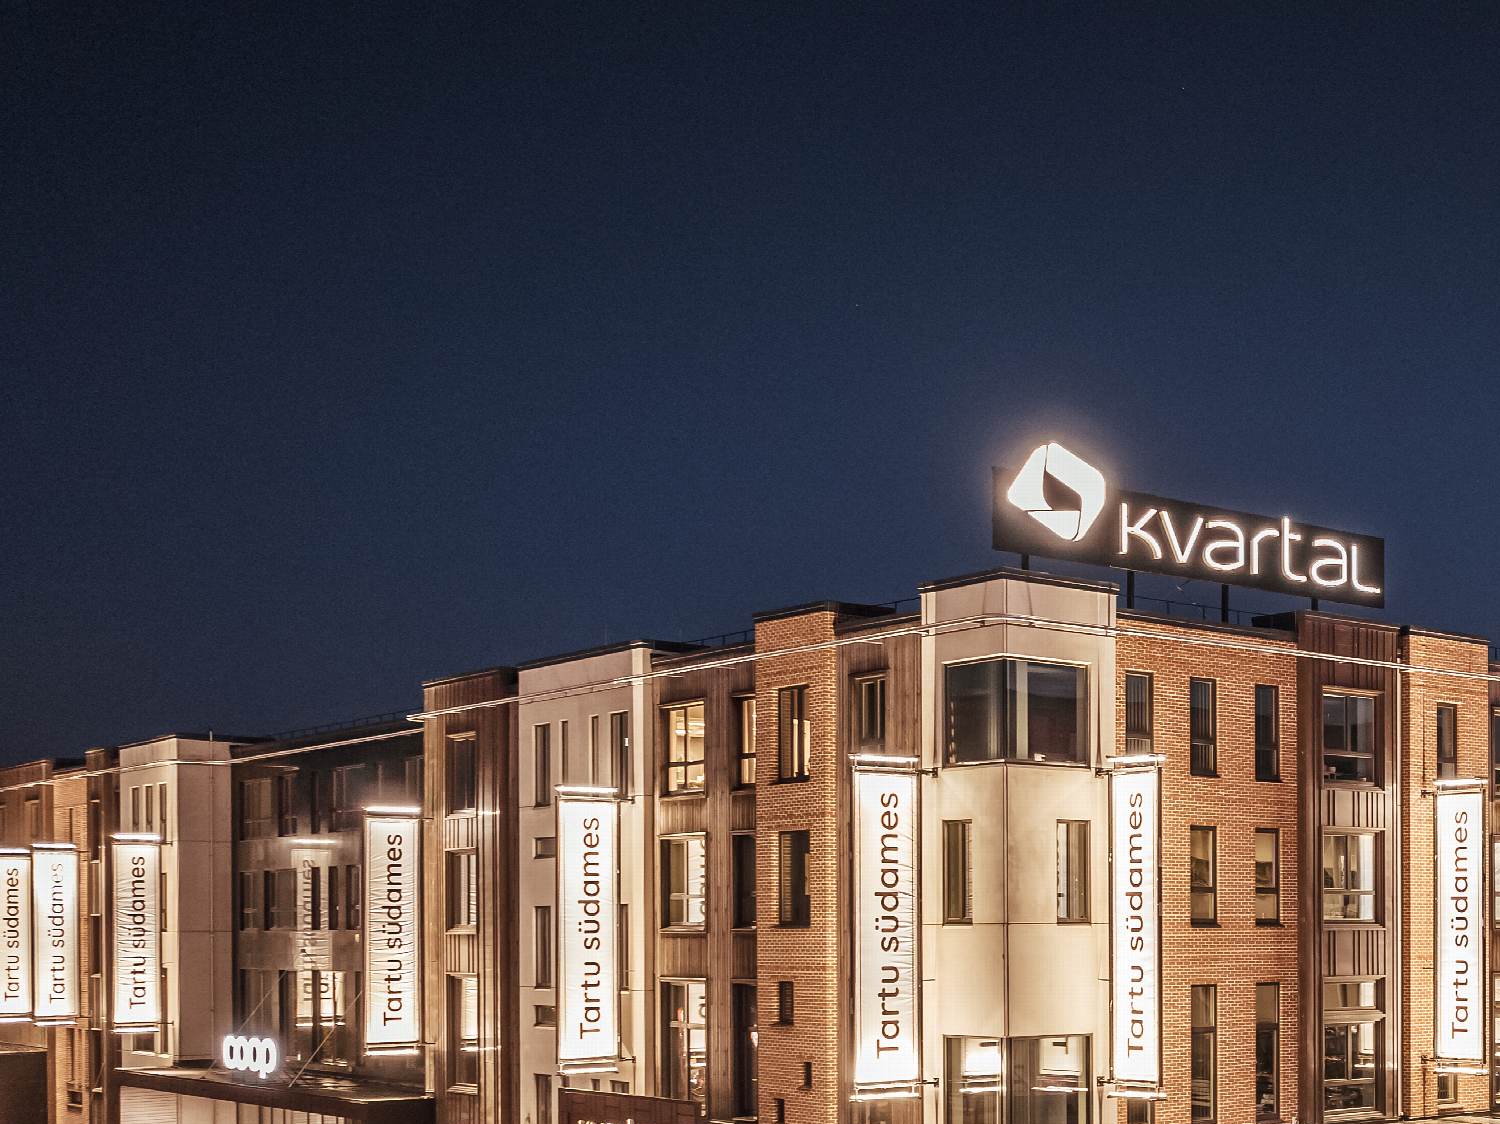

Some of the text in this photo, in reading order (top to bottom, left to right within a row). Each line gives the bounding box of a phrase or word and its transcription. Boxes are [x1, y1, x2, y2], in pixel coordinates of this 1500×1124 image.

[3, 868, 20, 1001] Tartu südames
[48, 863, 66, 1004] Tartu südames
[128, 856, 147, 1009] Tartu südames
[382, 834, 403, 1026] Tartu südames
[578, 817, 601, 1040] Tartu südames
[874, 792, 900, 1059] Tartu südames
[1125, 792, 1144, 1058] Tartu südames
[1450, 810, 1469, 1040] Tartu südames
[223, 1034, 278, 1079] coop
